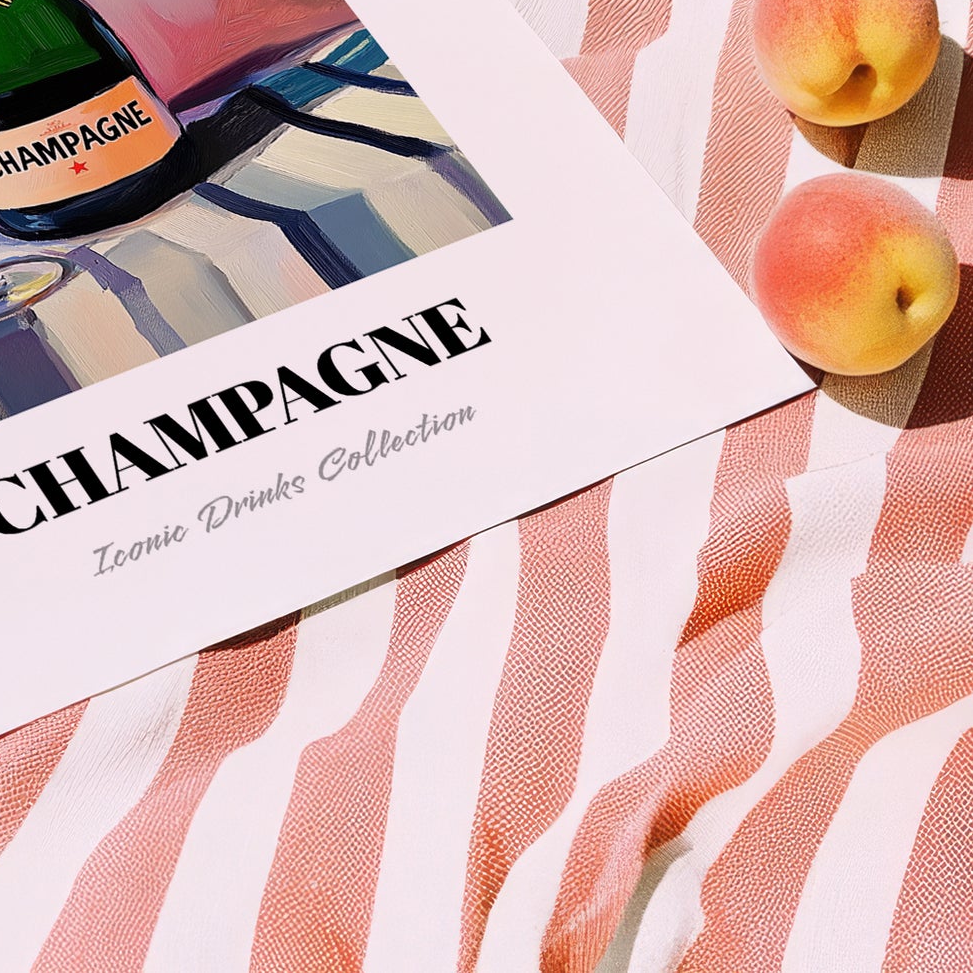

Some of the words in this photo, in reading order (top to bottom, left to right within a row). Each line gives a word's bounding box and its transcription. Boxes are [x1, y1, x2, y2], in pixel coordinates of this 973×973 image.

[92, 525, 189, 577] Iconic
[197, 472, 306, 534] Drinks
[318, 404, 477, 482] Collection
